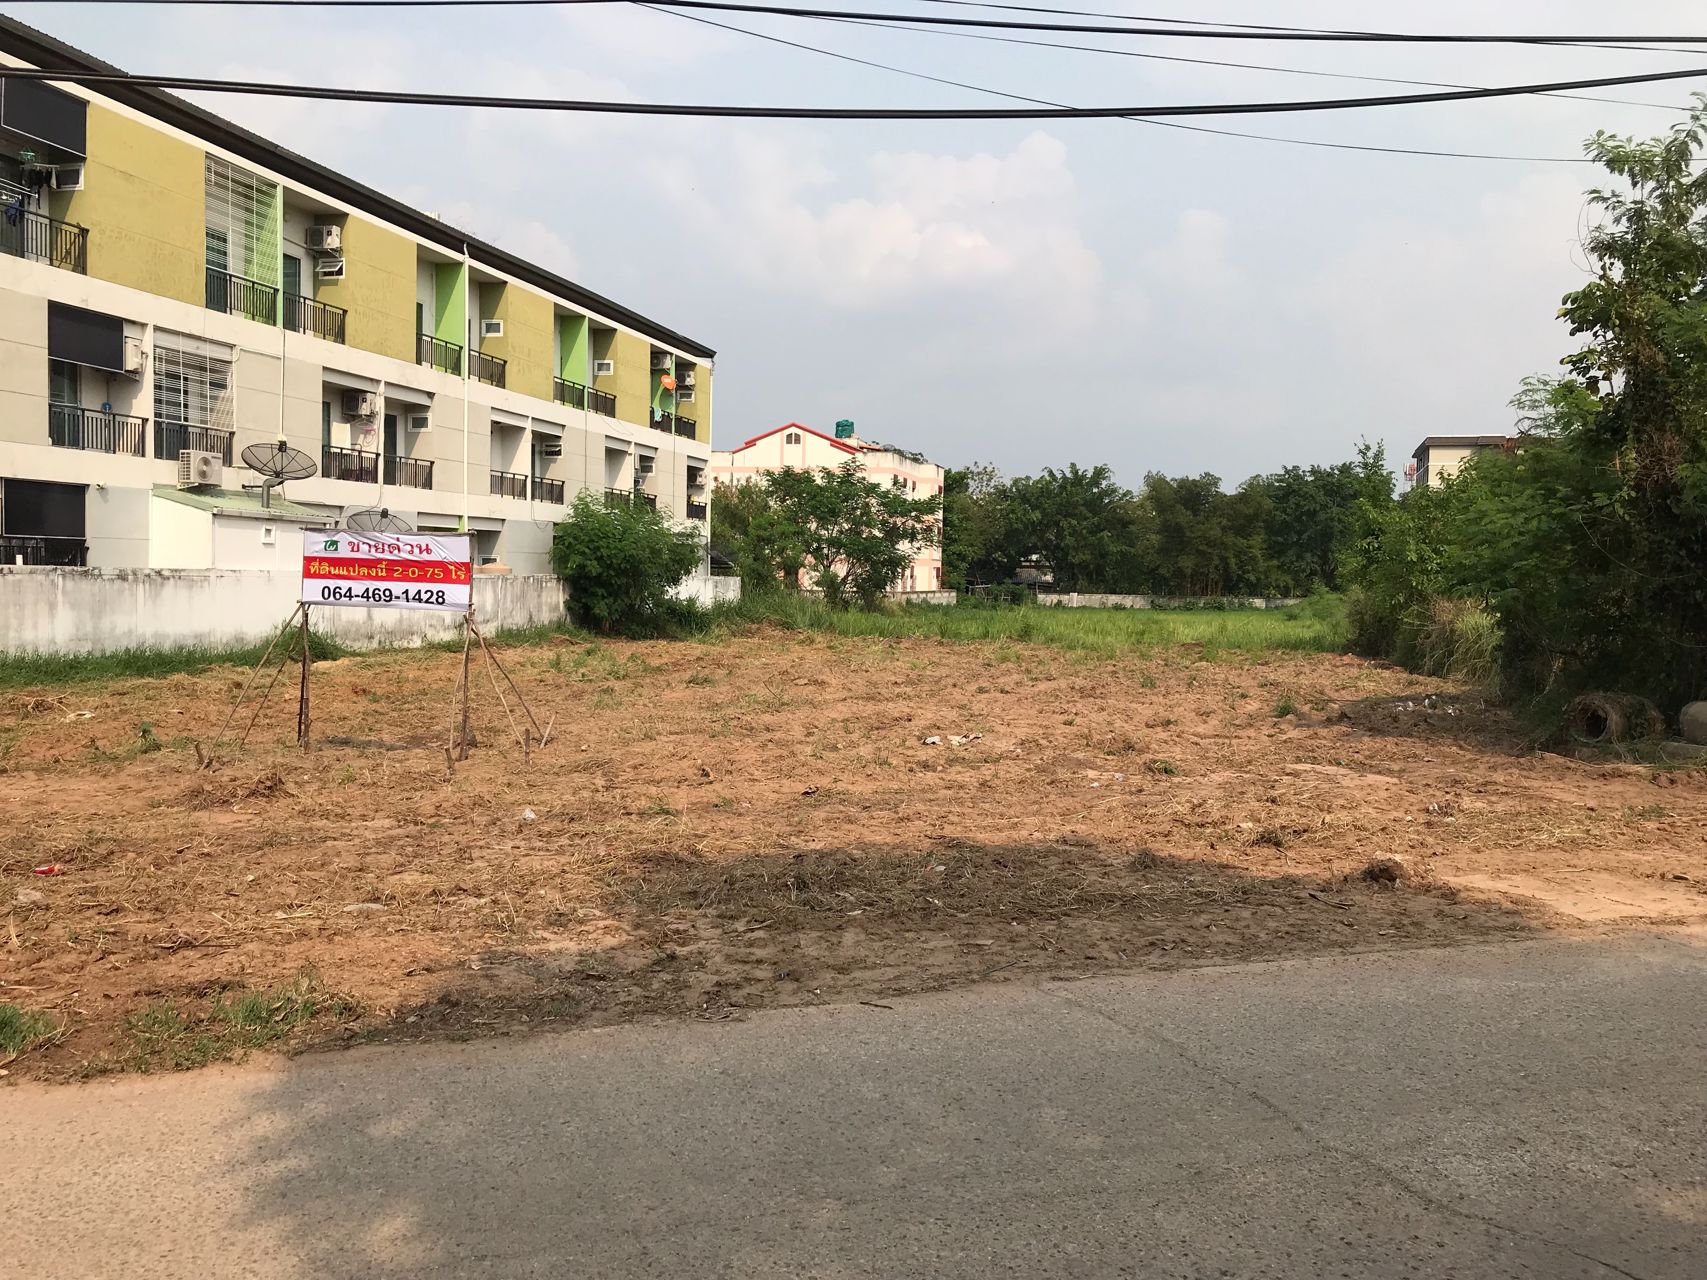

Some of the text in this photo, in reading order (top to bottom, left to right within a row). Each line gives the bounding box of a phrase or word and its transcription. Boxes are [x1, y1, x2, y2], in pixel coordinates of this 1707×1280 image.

[347, 537, 432, 555] ขายด่วน
[309, 560, 466, 580] ที่ดินแปลงนี้ 2-0-75 ไร่
[321, 585, 446, 605] 064-469-1428
